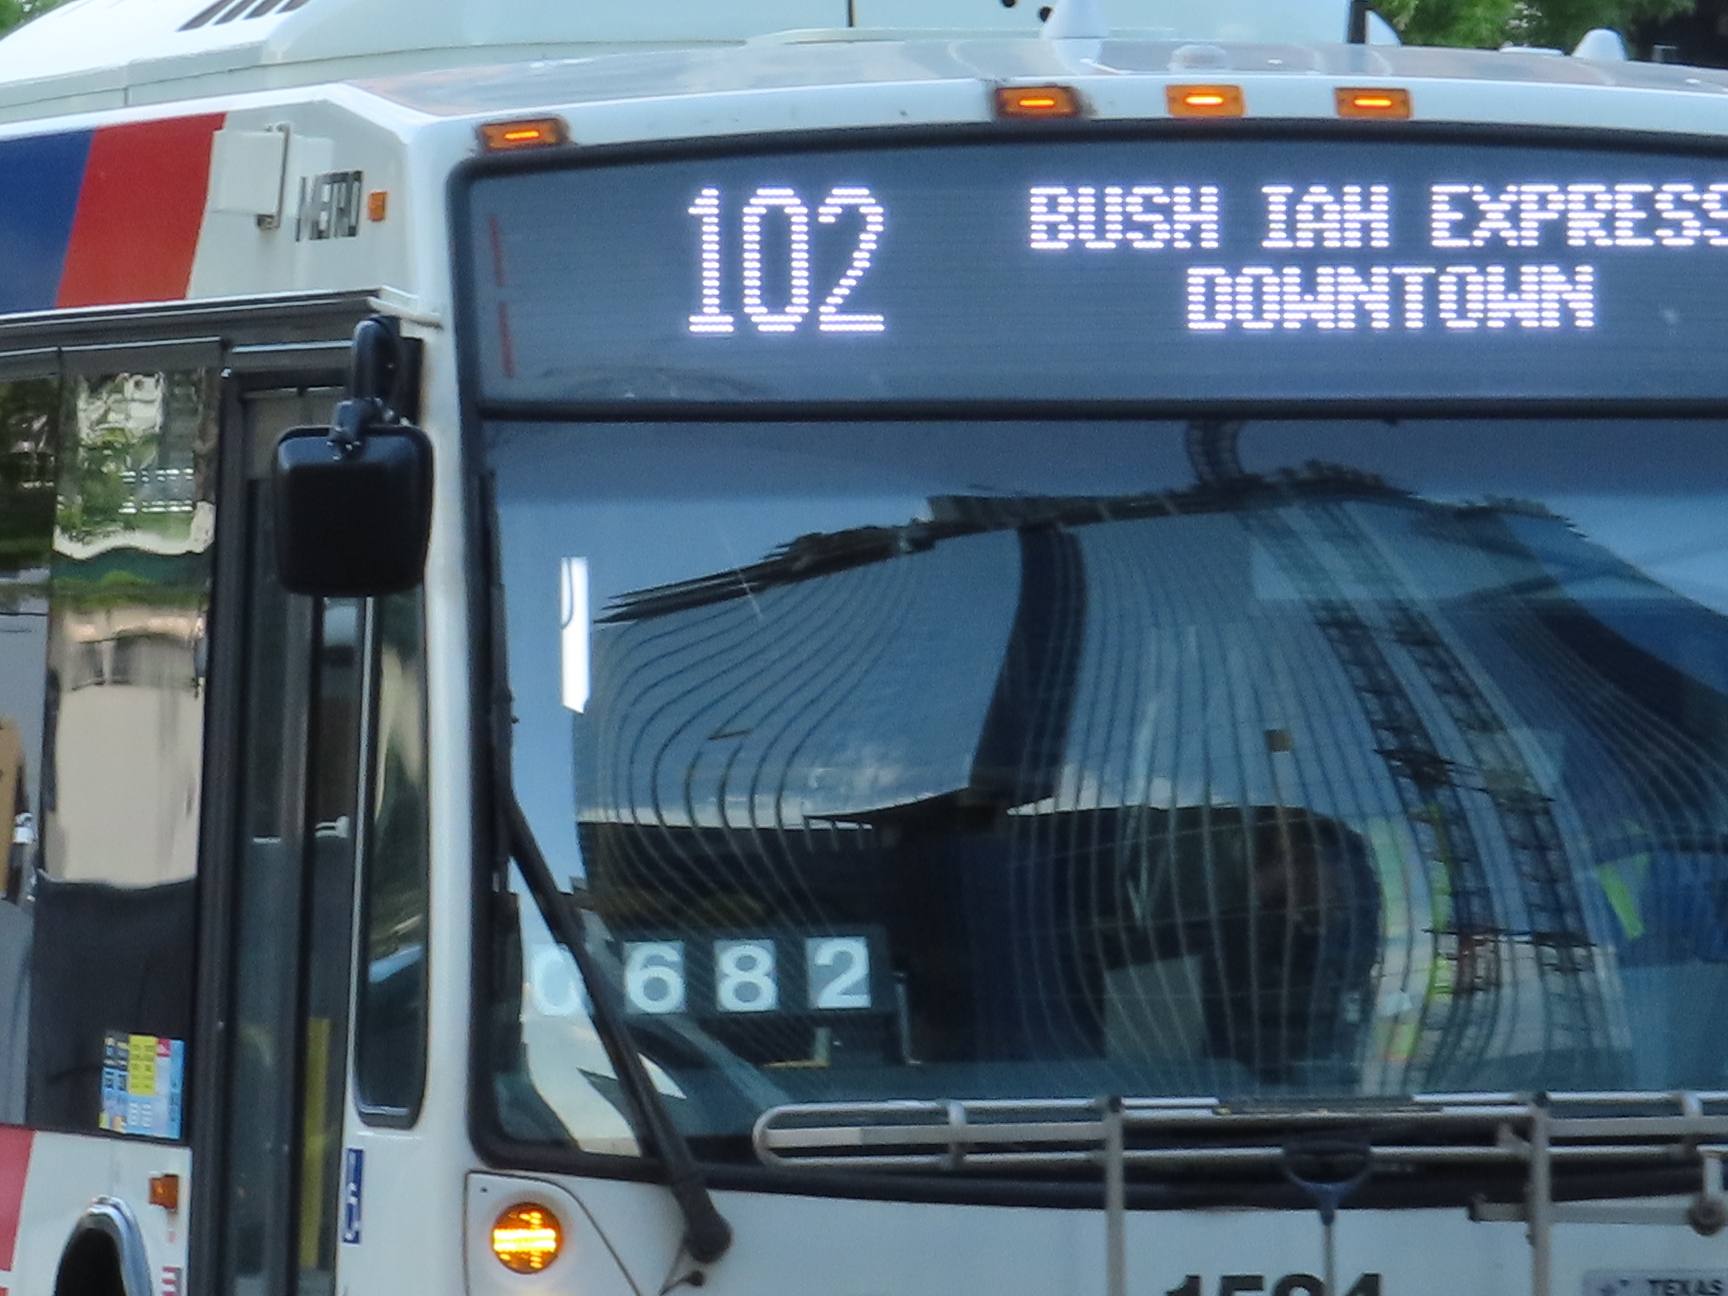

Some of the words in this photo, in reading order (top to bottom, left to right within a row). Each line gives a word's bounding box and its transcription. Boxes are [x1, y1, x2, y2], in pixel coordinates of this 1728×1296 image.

[1030, 186, 1220, 249] BUSH
[1261, 184, 1390, 248] IAH
[687, 187, 885, 333] 102
[1186, 265, 1594, 330] DOWNTOWN
[1647, 1279, 1724, 1296] TEXAS
